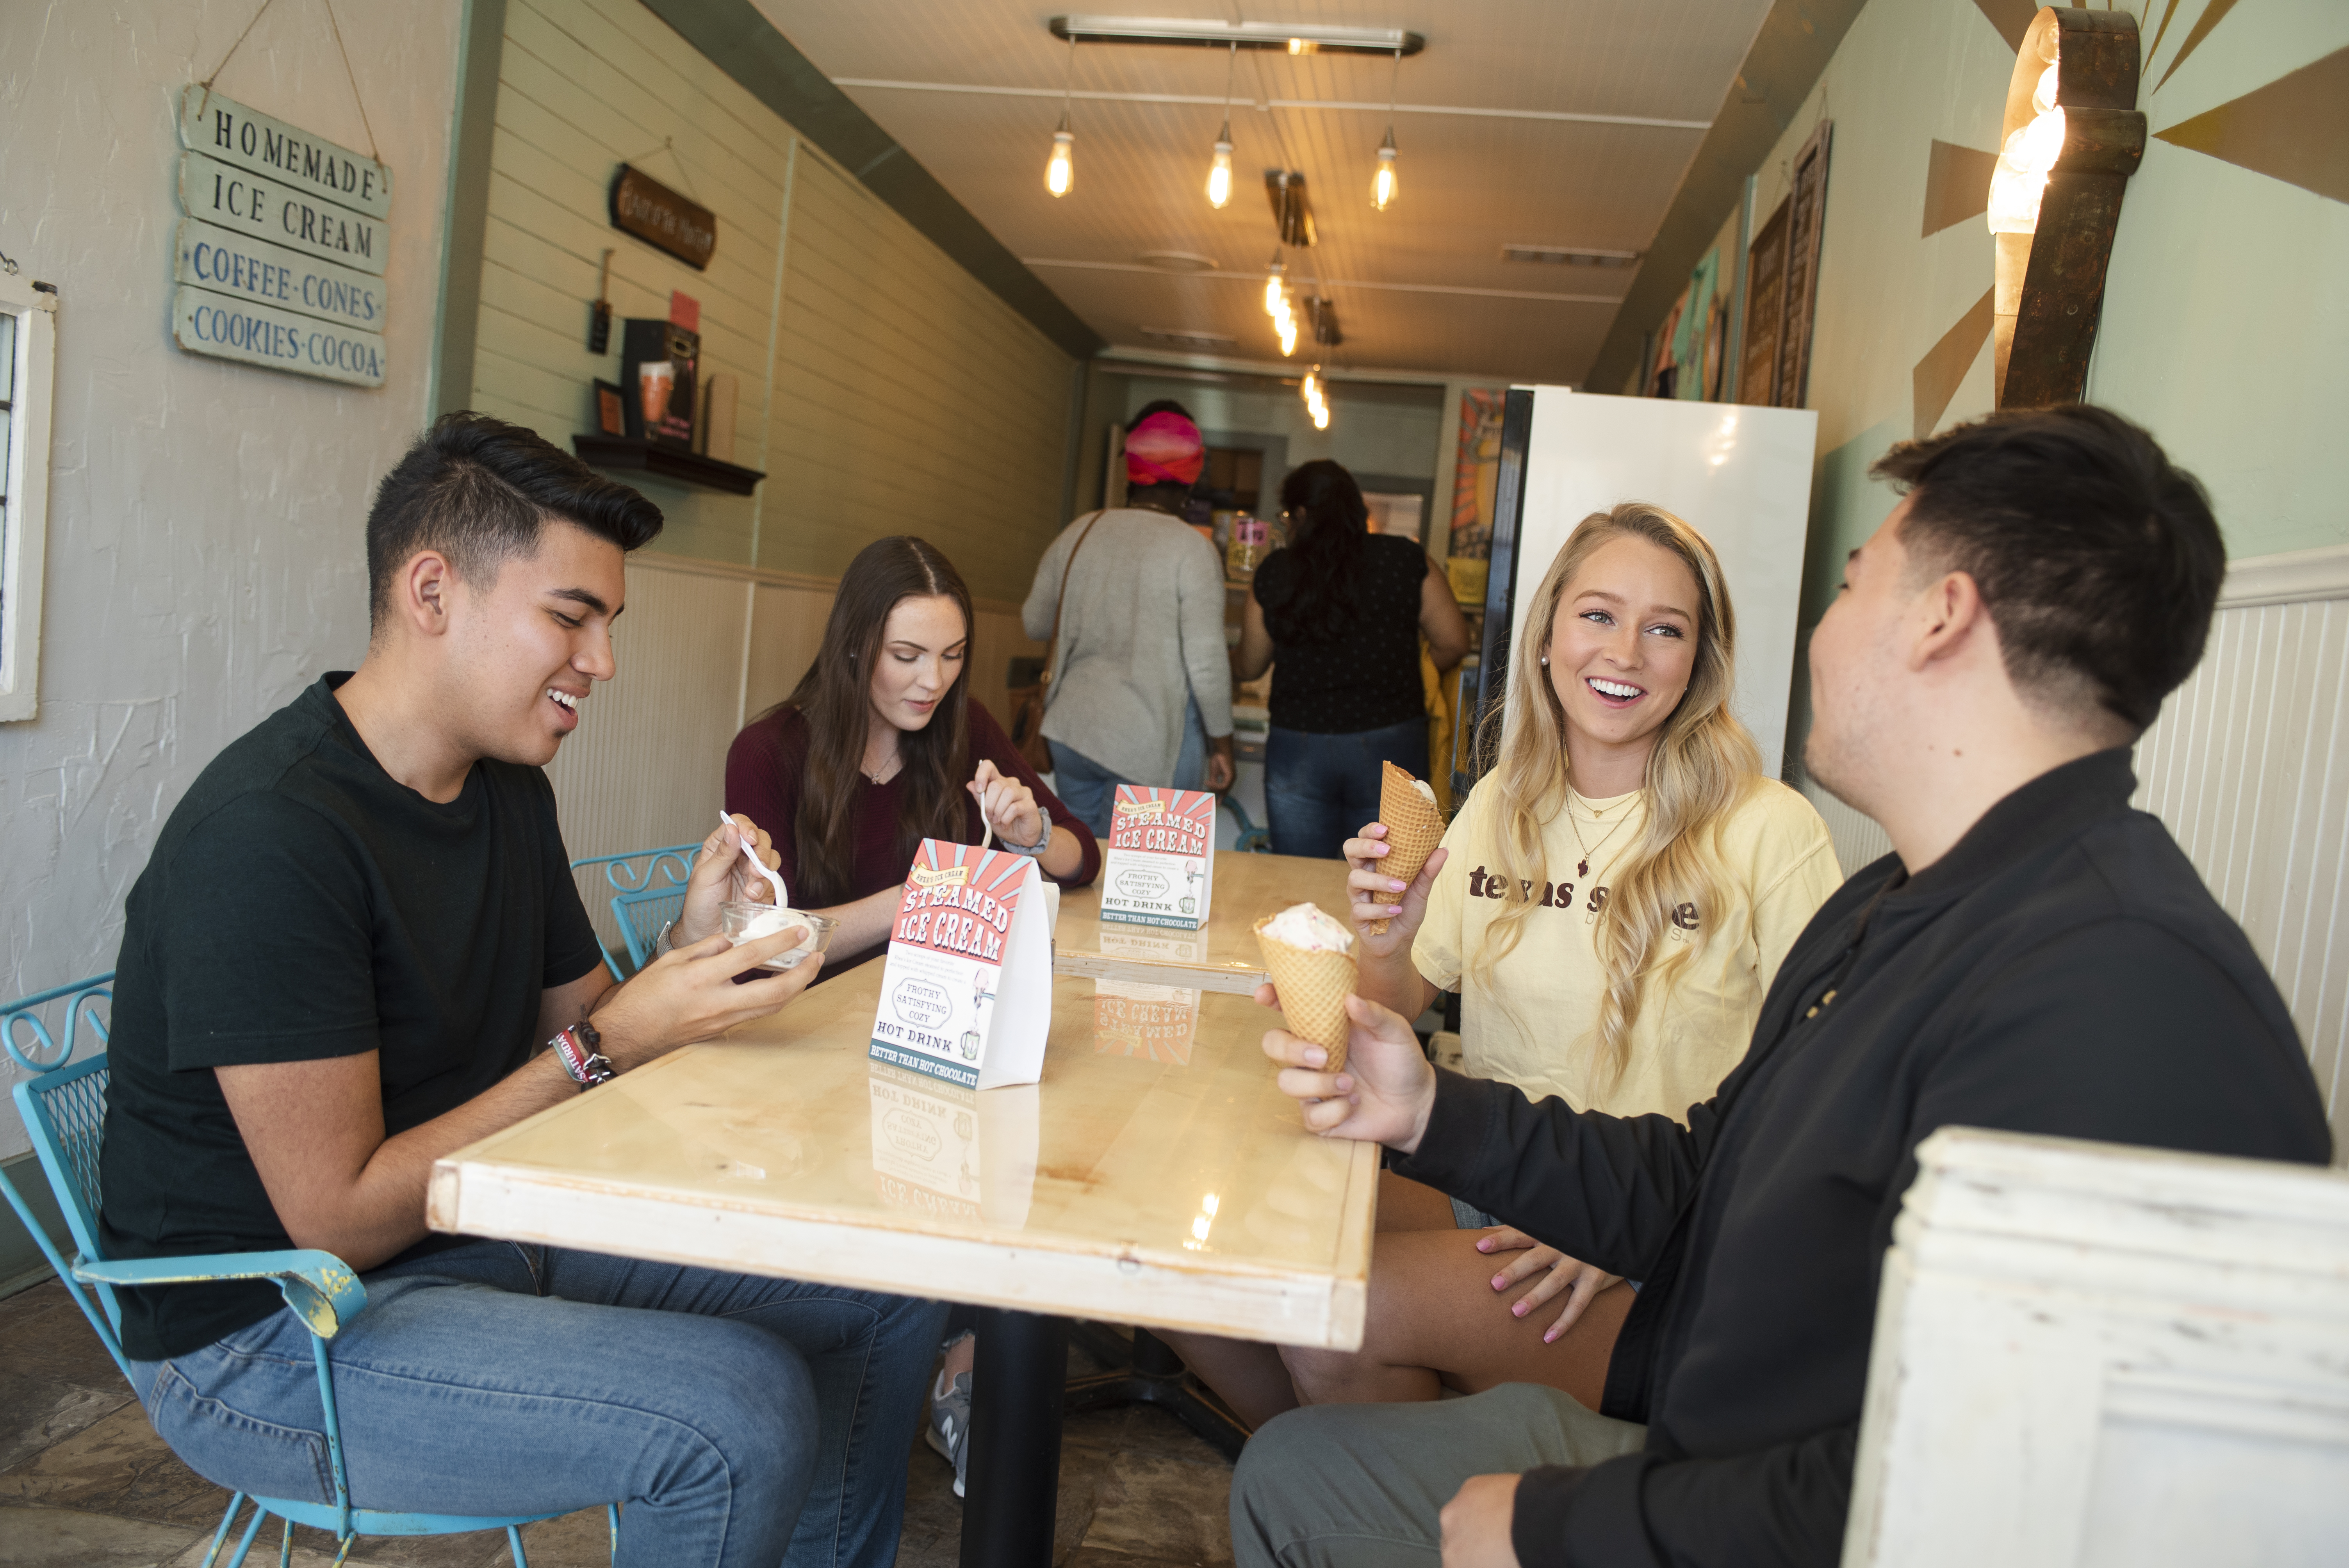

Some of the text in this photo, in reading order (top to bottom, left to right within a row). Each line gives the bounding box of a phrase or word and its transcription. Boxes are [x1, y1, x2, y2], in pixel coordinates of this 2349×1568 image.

[215, 109, 375, 201] HOMEMADE
[213, 174, 371, 258] ICE CREAM
[1116, 813, 1206, 839] STEAMED
[1115, 829, 1203, 855] ICE CREAM
[1120, 880, 1165, 890] SATISFYING
[903, 885, 1008, 933] STEAMED
[1105, 898, 1173, 911] HOT DRINK
[1102, 912, 1197, 929] BETTER THAN HOT CHOCOLATE
[898, 911, 1002, 961] ICE CREAM
[897, 994, 946, 1014] SATISFYING
[907, 984, 941, 999] FROTHY
[909, 1010, 930, 1023] COZY
[877, 1021, 953, 1053] HOT DRINK
[871, 1045, 977, 1086] BETTER THAN HOT CHOCOLATE
